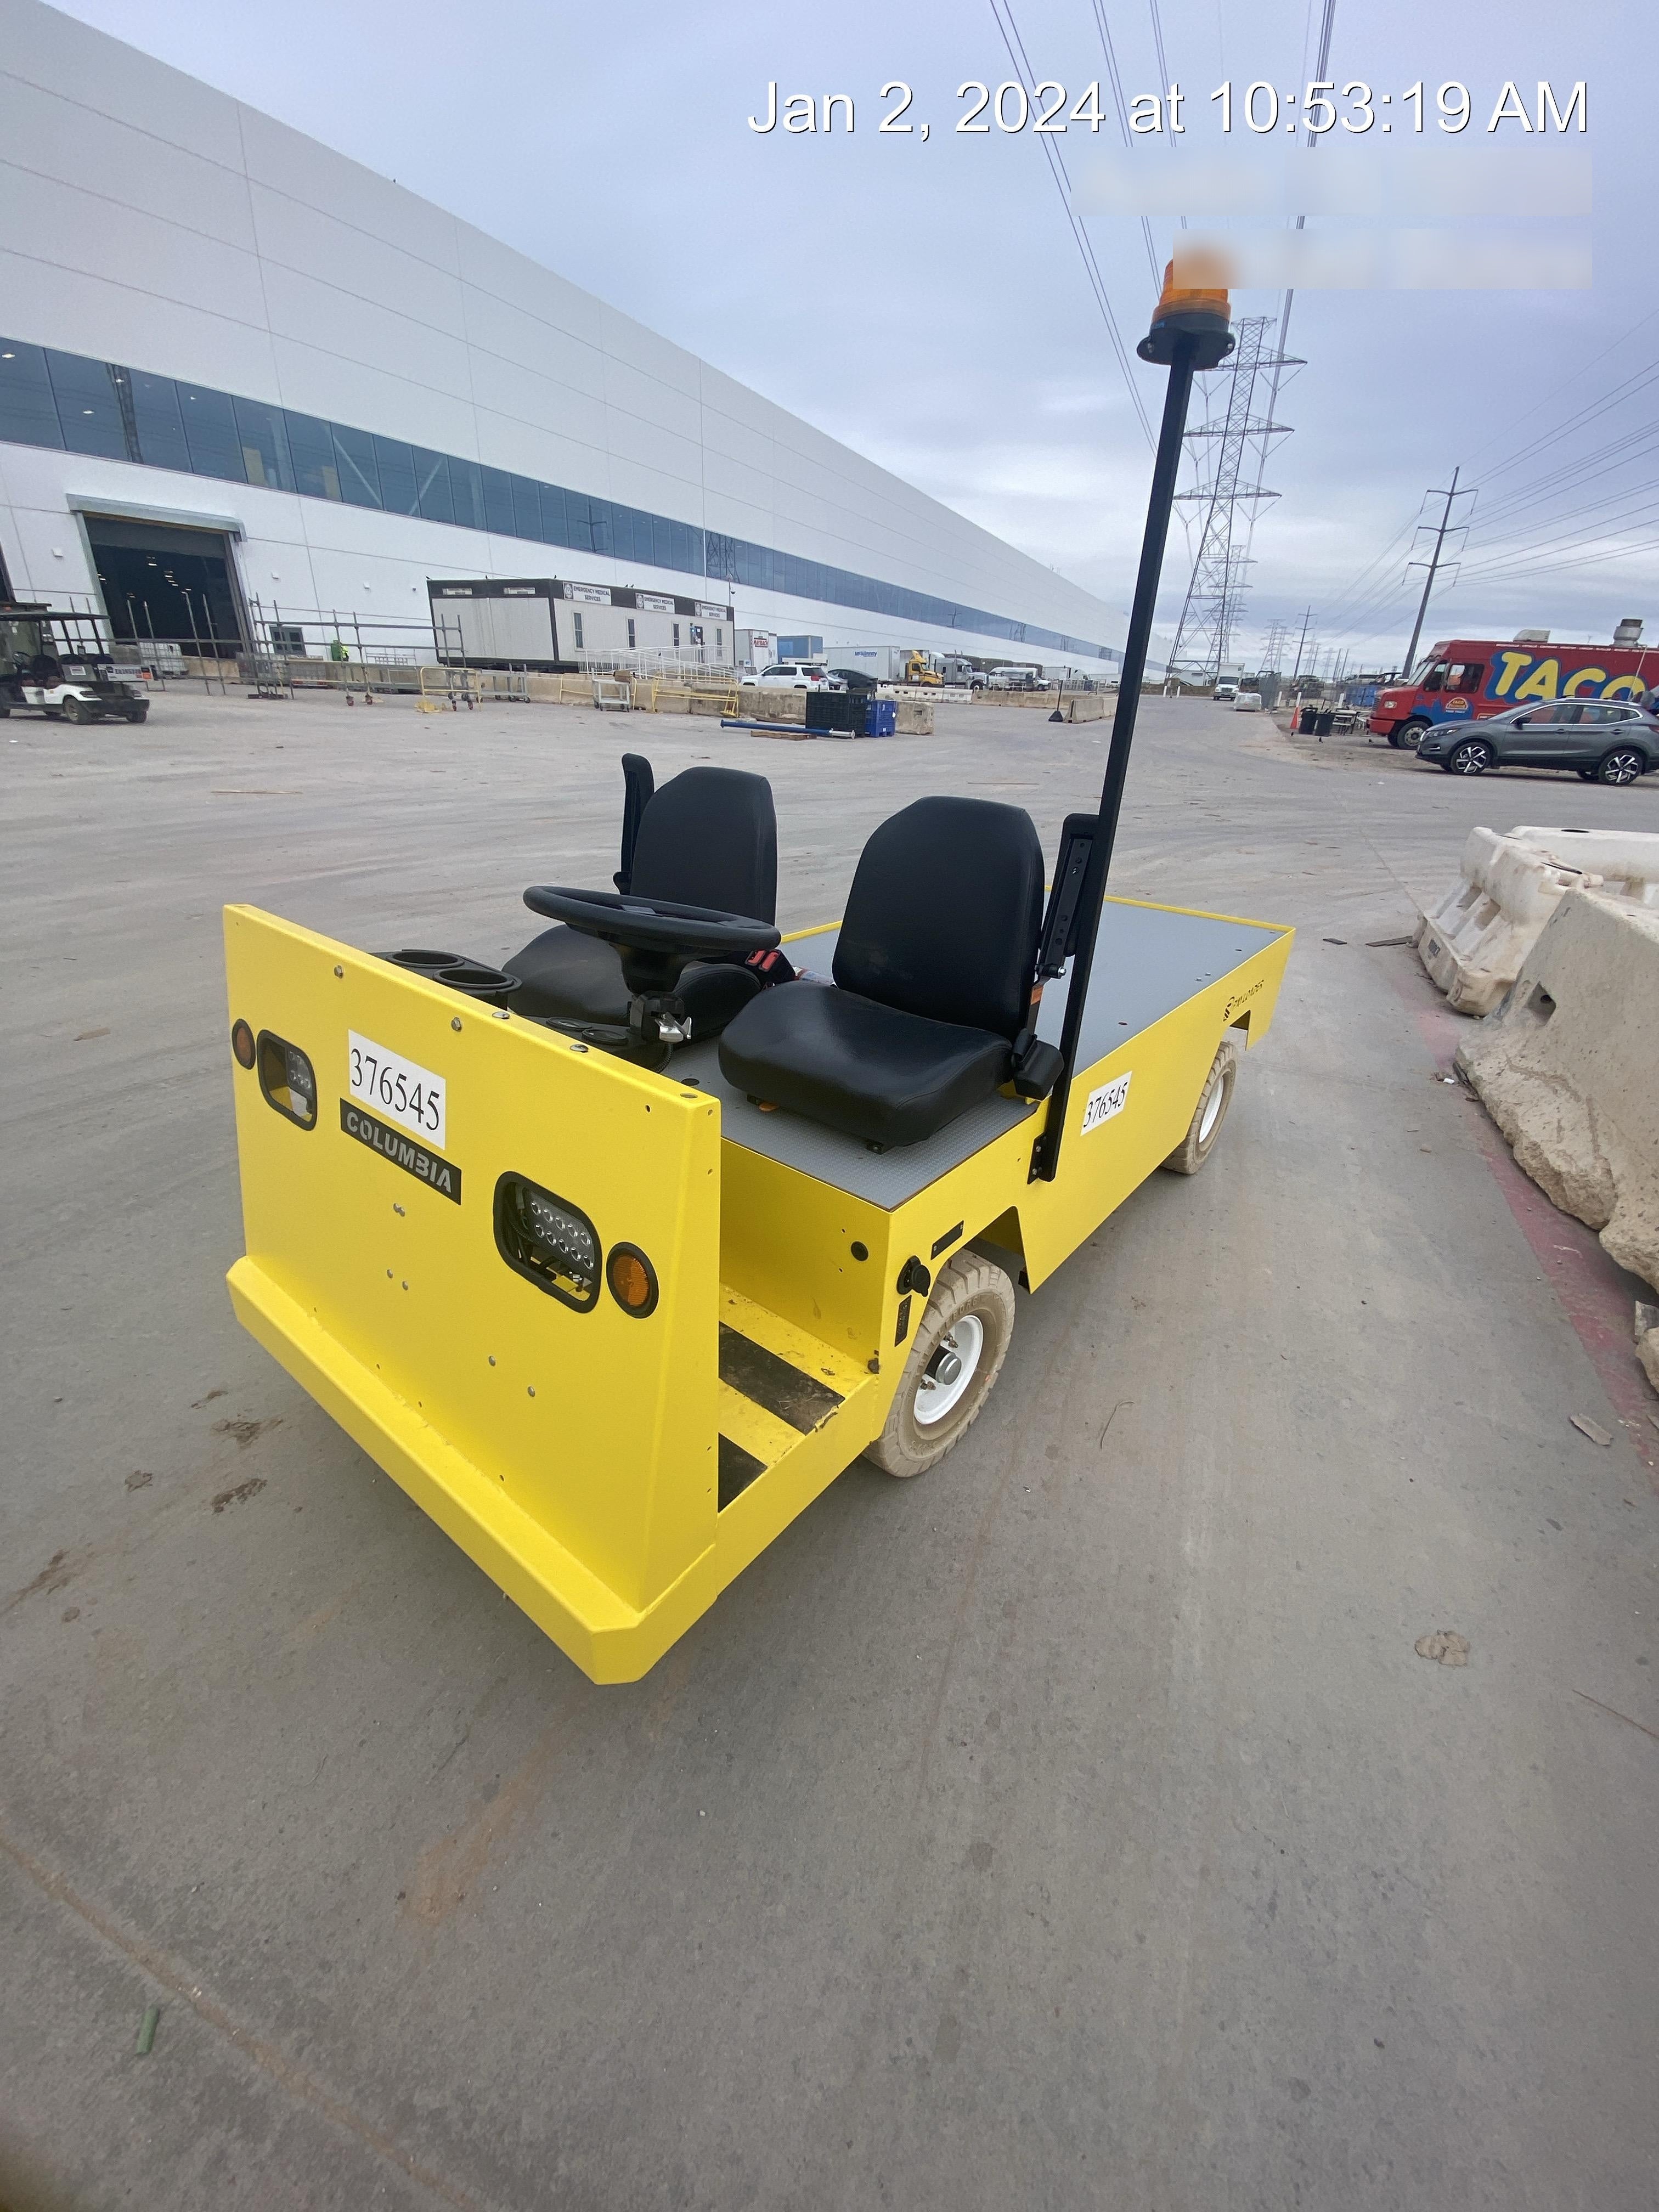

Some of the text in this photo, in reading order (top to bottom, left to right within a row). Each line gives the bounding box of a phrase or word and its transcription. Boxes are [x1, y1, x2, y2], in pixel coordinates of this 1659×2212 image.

[573, 585, 611, 596] EMERGENCY MEDICAL
[351, 1048, 440, 1131] 376545
[1083, 1081, 1128, 1128] 376545
[347, 1111, 452, 1193] COLUMBIA
